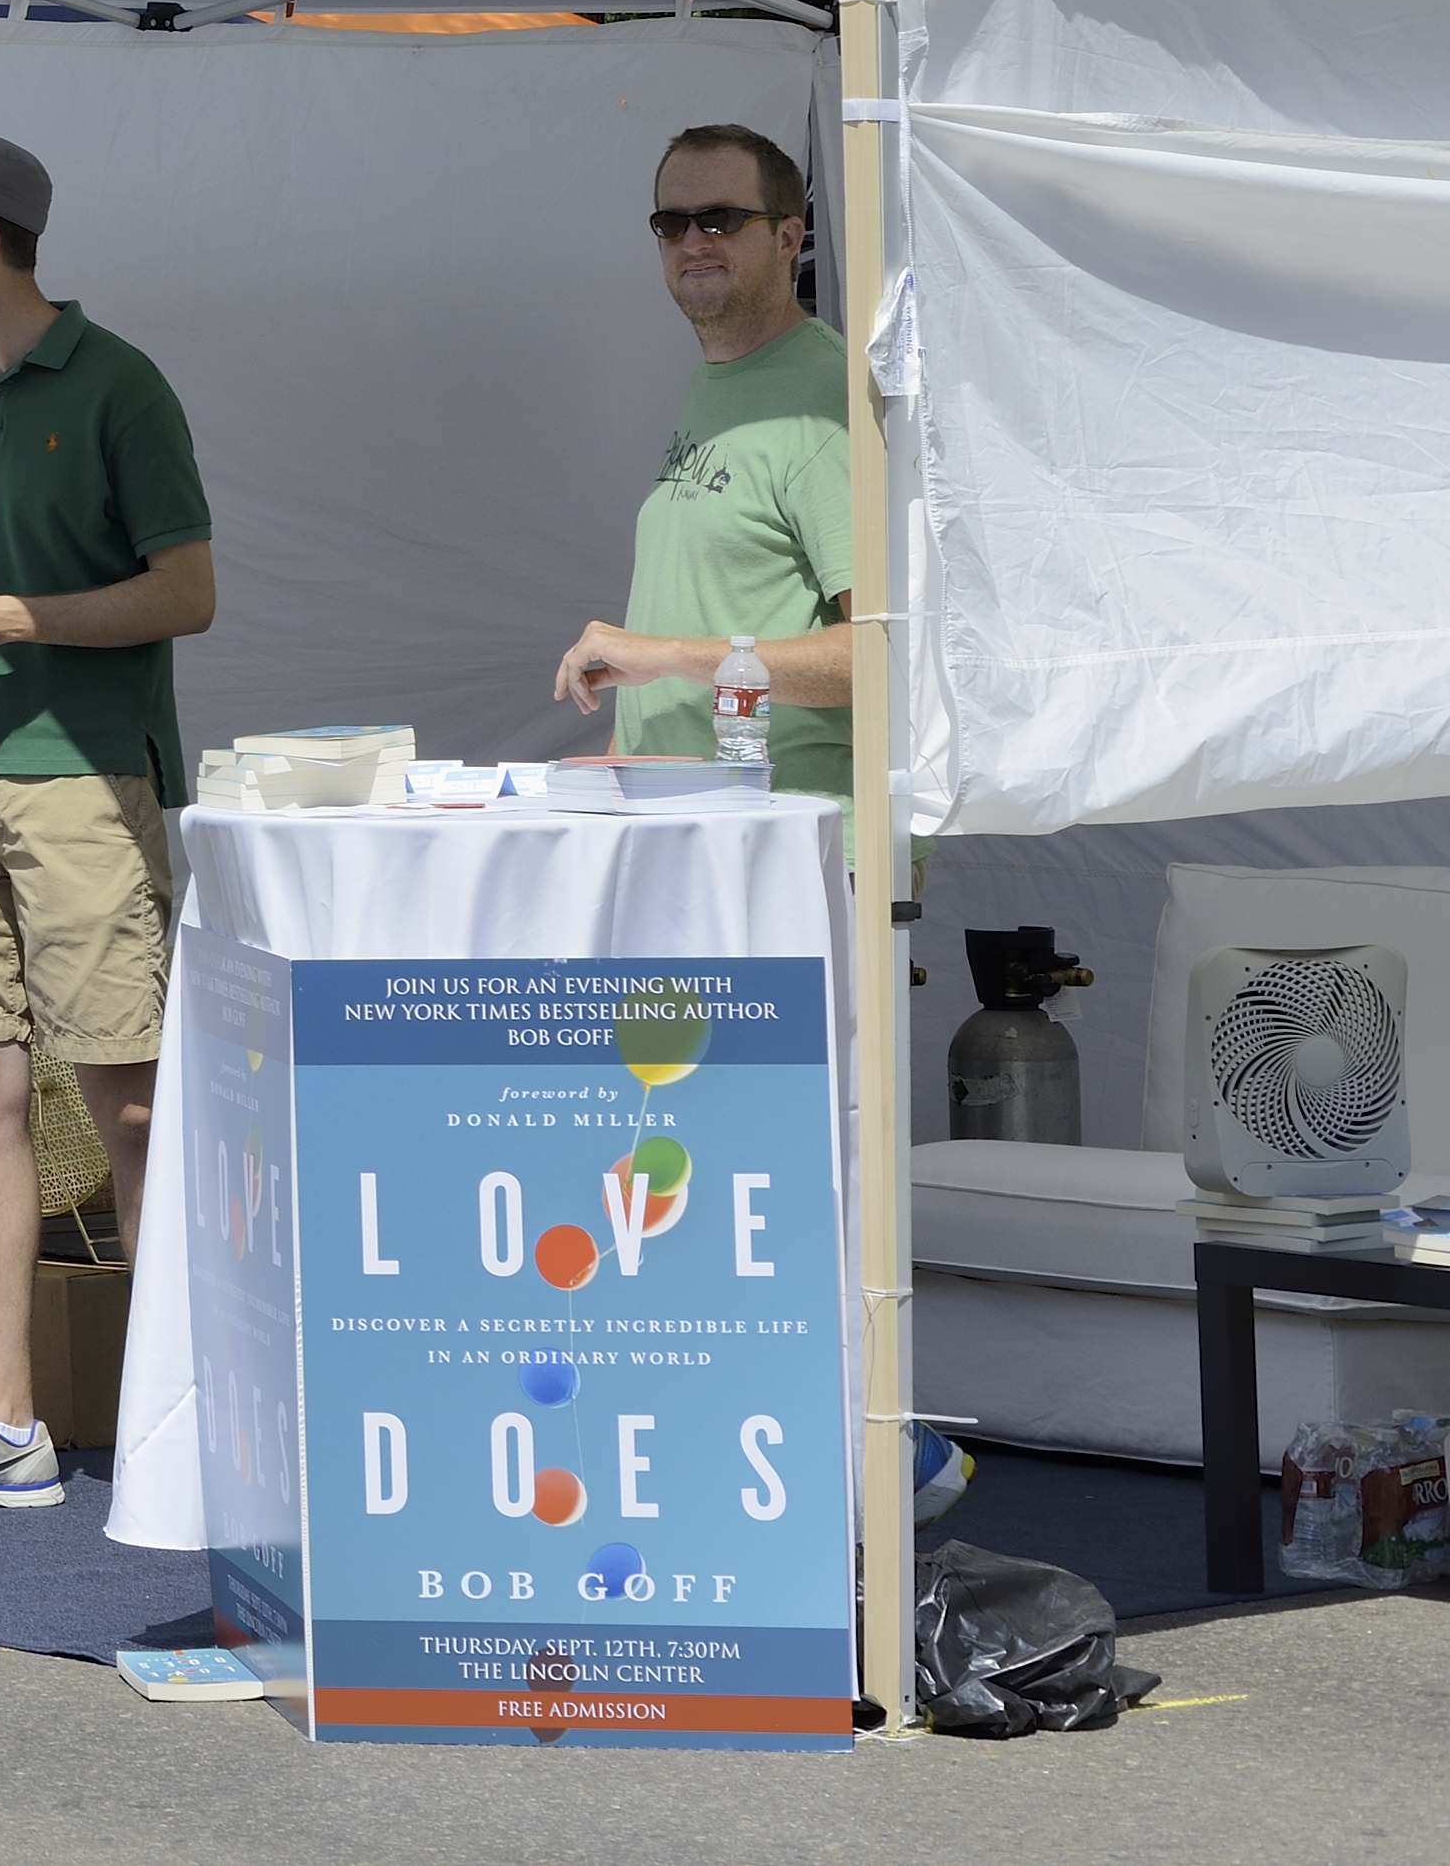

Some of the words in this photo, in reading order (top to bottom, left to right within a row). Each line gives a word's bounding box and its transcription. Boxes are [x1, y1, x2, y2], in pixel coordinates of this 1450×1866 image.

[386, 978, 436, 999] JOIN
[443, 977, 470, 995] US
[477, 977, 522, 995] FOR
[525, 977, 557, 995] AN
[565, 976, 664, 994] EVENING
[670, 976, 732, 994] WITH
[345, 1003, 399, 1021] NEW
[400, 1003, 463, 1021] YORK
[465, 1003, 531, 1020] TIMES
[539, 1002, 676, 1020] BESTSELLING
[682, 1002, 779, 1020] AUTHOR
[508, 1028, 551, 1046] BOB
[556, 1028, 614, 1046] GOFF
[498, 1086, 590, 1103] foreword
[597, 1086, 619, 1103] by
[447, 1113, 556, 1127] DONALD
[572, 1113, 679, 1128] MILLER
[360, 1168, 775, 1279] LOVE
[331, 1317, 447, 1332] DISCOVER
[457, 1319, 470, 1332] A
[480, 1318, 595, 1333] SECRETLY
[606, 1319, 747, 1334] INCREDIBLE
[757, 1320, 808, 1334] LIFE
[428, 1350, 451, 1364] IN
[462, 1350, 490, 1364] AN
[500, 1350, 619, 1365] ORDINARY
[629, 1351, 711, 1366] WORLD
[363, 1411, 787, 1523] DOES
[418, 1570, 535, 1600] BOB
[577, 1566, 736, 1603] GOFF
[419, 1636, 540, 1658] THURSDAY,
[546, 1638, 598, 1657] SEPT.
[604, 1639, 661, 1658] 12TH,
[667, 1640, 741, 1659] 7:30PM
[458, 1661, 503, 1680] THE
[510, 1662, 609, 1681] LINCOLN
[616, 1664, 705, 1684] CENTER
[498, 1700, 543, 1718] FREE
[549, 1701, 666, 1720] ADMISSION
